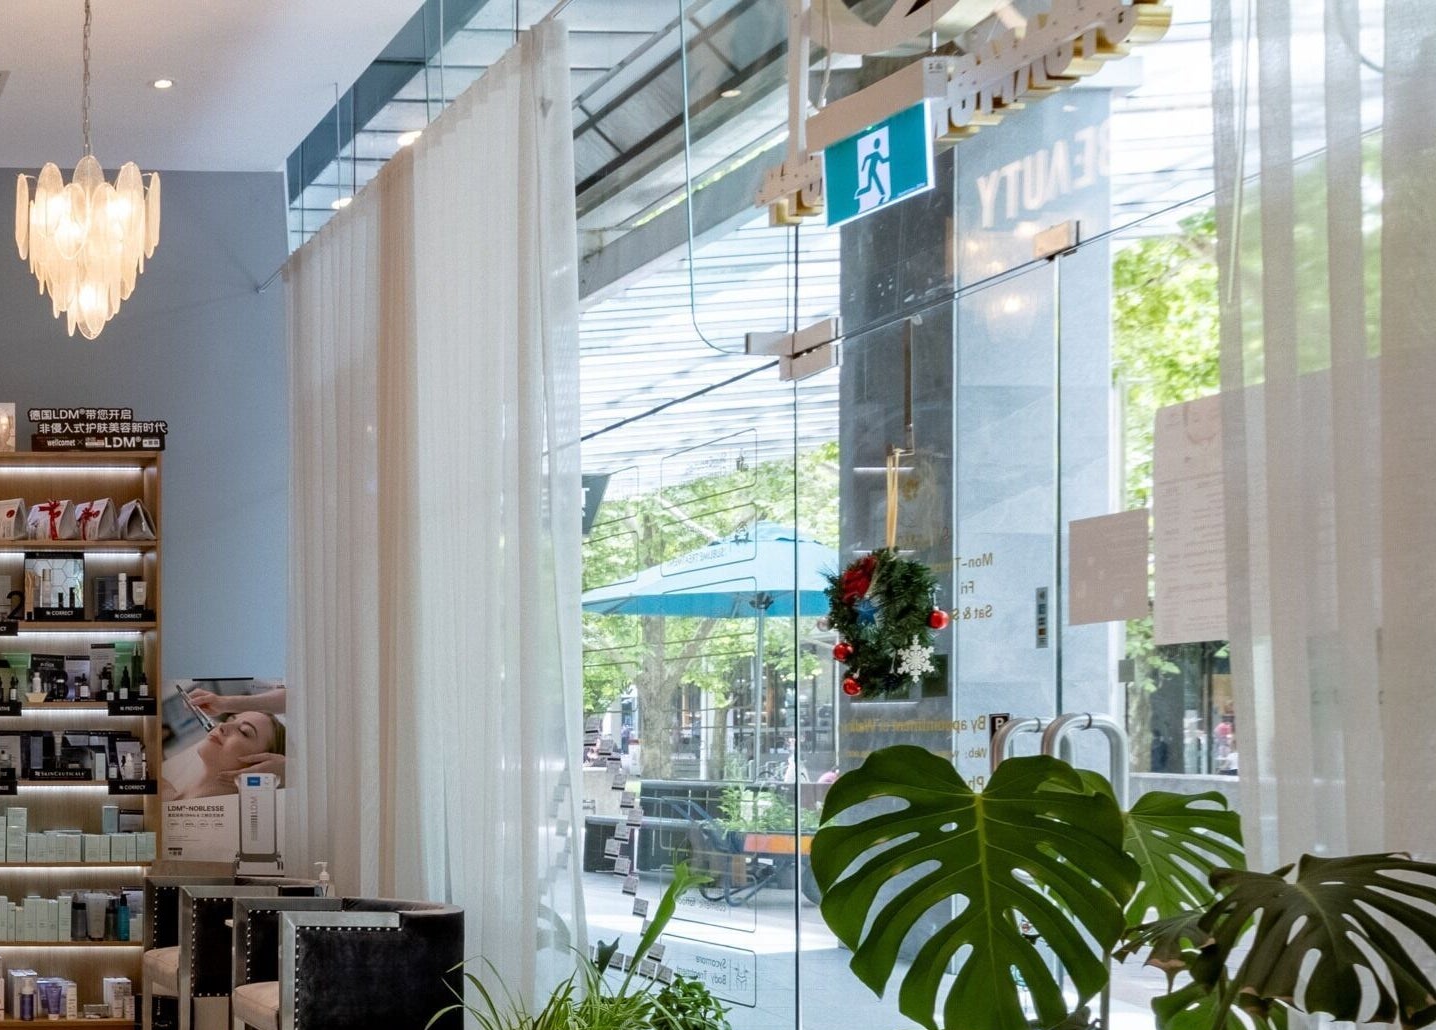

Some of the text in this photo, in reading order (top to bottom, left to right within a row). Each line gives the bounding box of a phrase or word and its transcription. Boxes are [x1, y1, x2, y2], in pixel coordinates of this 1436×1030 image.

[39, 422, 167, 434] 非侵入式护肤美容新时代
